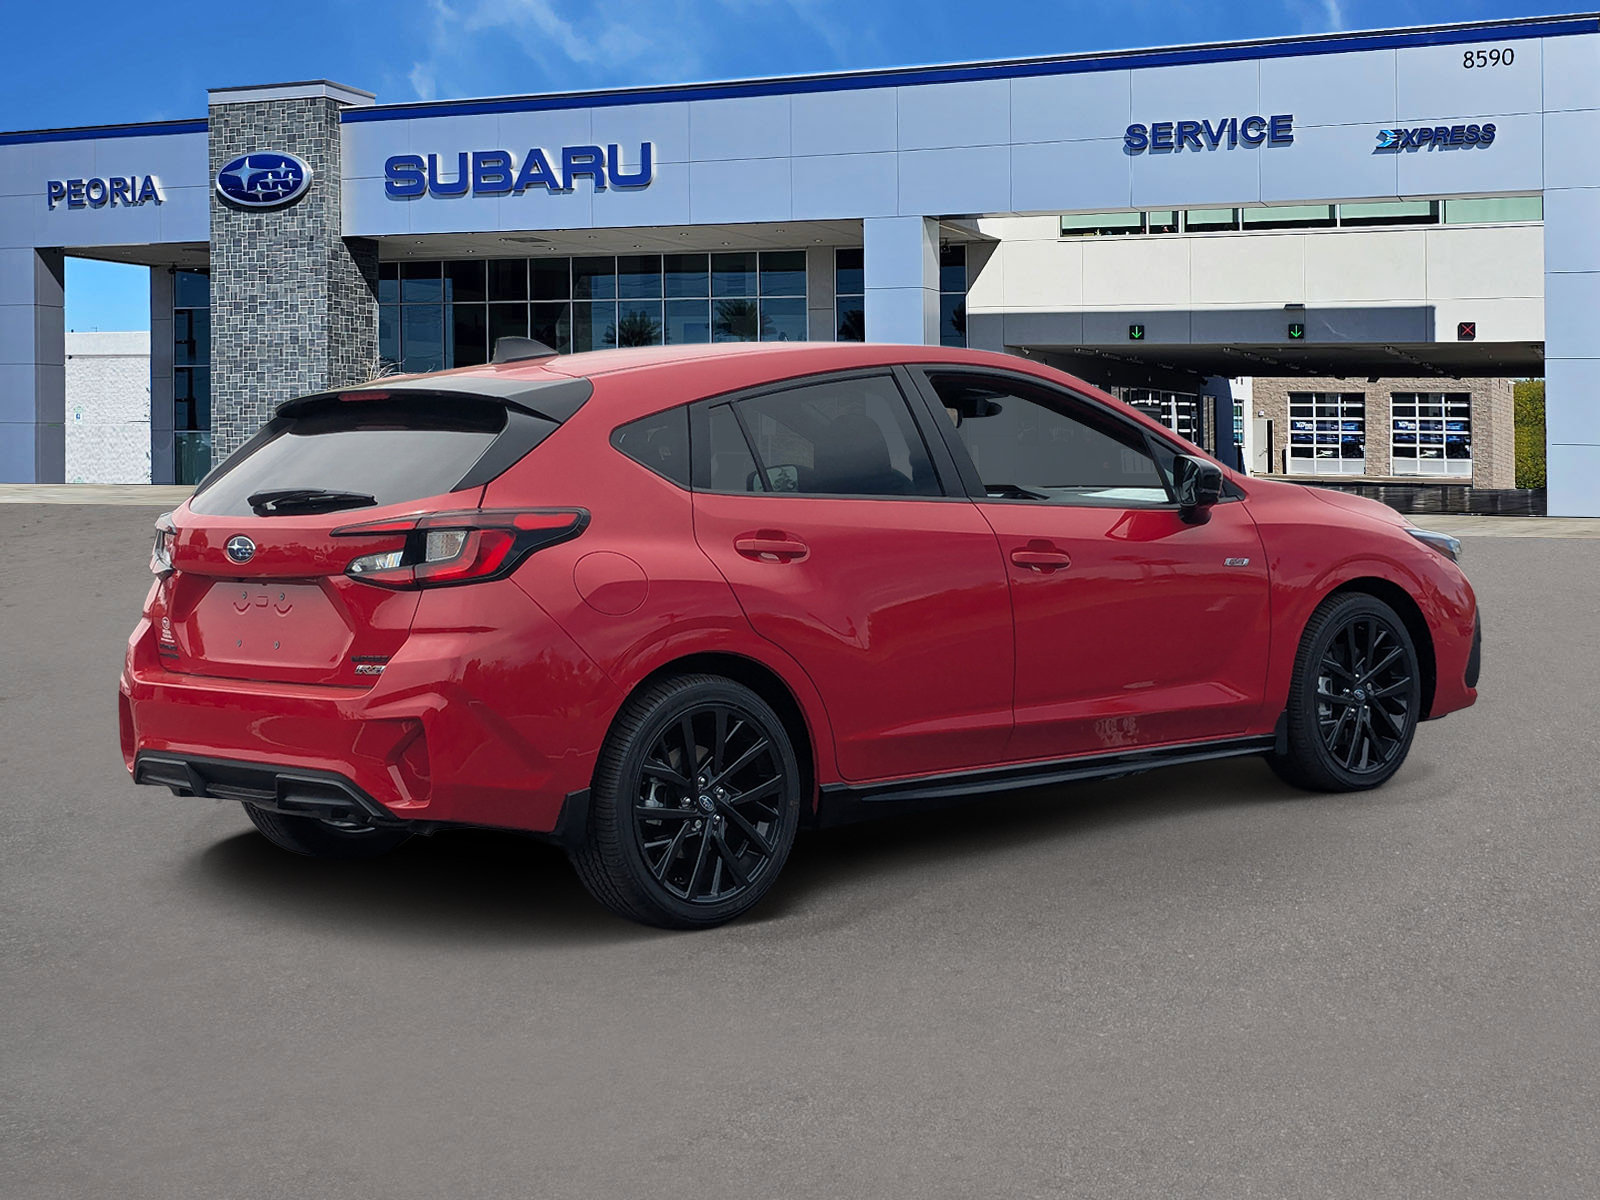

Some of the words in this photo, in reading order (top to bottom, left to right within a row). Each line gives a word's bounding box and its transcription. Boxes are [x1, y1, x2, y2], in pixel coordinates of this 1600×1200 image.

[1463, 48, 1515, 69] 8590
[1124, 114, 1294, 151] SERVICE
[1376, 123, 1497, 149] EXPRESS
[384, 141, 653, 197] SUBARU
[47, 175, 162, 209] PEORIA
